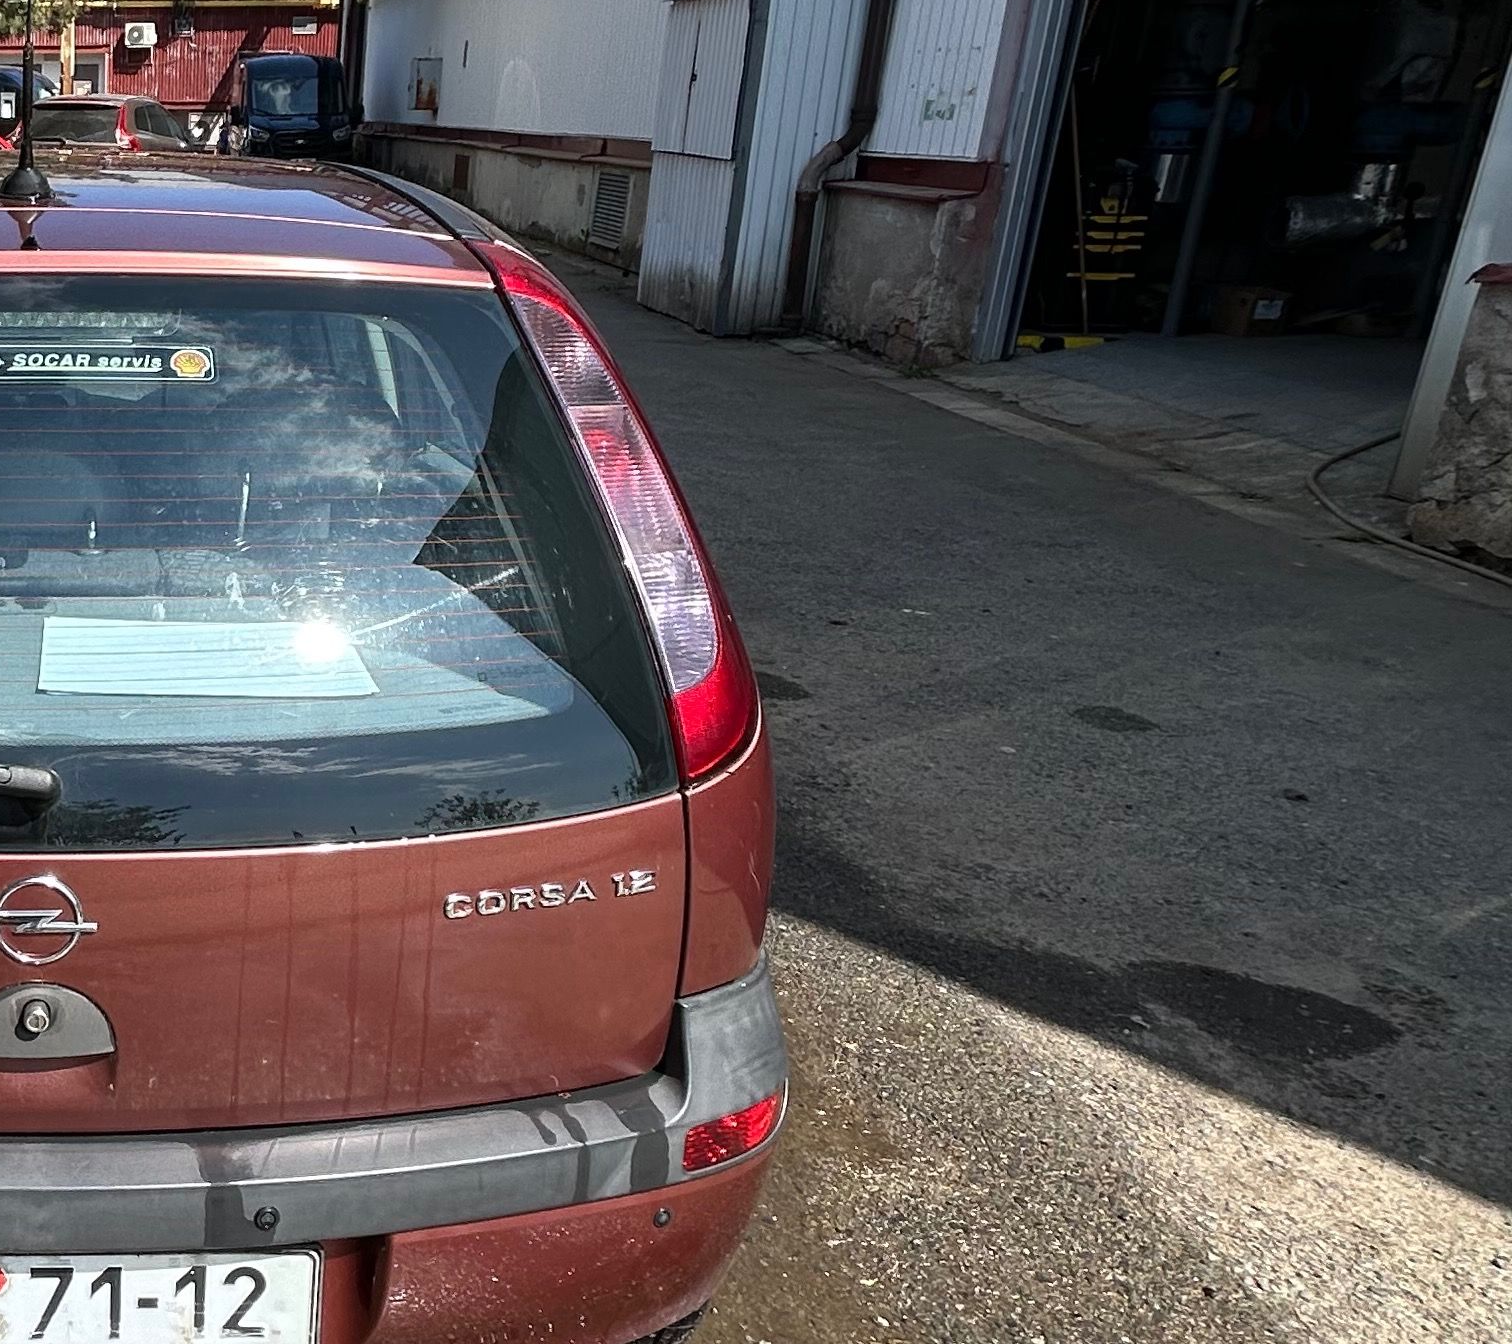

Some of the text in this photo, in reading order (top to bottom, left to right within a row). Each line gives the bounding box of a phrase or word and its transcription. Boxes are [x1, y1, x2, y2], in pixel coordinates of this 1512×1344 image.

[12, 352, 91, 368] SOCAR
[97, 353, 163, 369] servis
[442, 877, 598, 920] CORSA
[28, 1265, 268, 1342] 71-12
